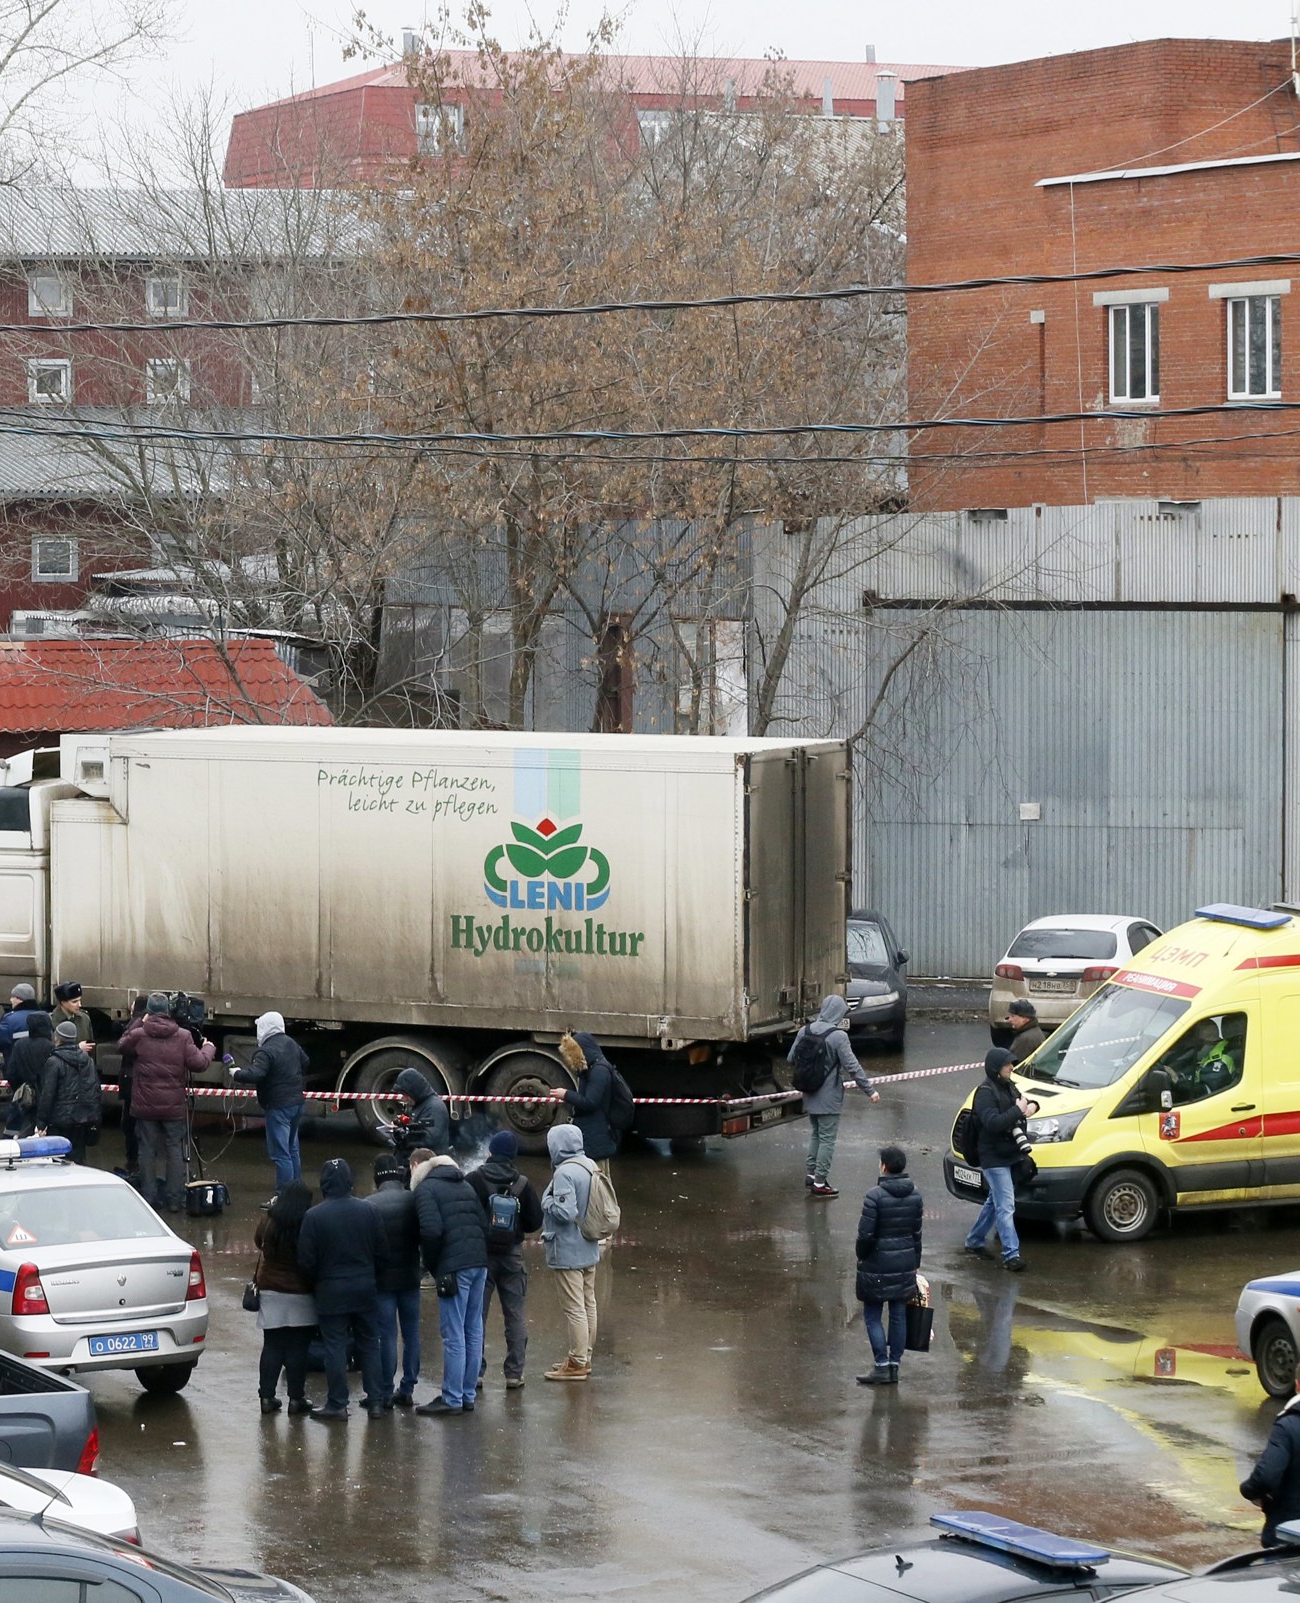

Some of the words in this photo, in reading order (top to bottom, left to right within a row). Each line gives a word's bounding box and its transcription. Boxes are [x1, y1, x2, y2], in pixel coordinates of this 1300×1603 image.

[317, 766, 403, 795] Prächtige
[412, 769, 496, 792] Pflanzen,
[348, 790, 399, 812] leicht
[405, 800, 427, 814] zu
[432, 793, 499, 822] pflegen
[509, 880, 585, 911] LENI
[450, 914, 645, 958] Hydrokultur
[107, 1336, 137, 1351] 0622
[142, 1333, 154, 1344] 99
